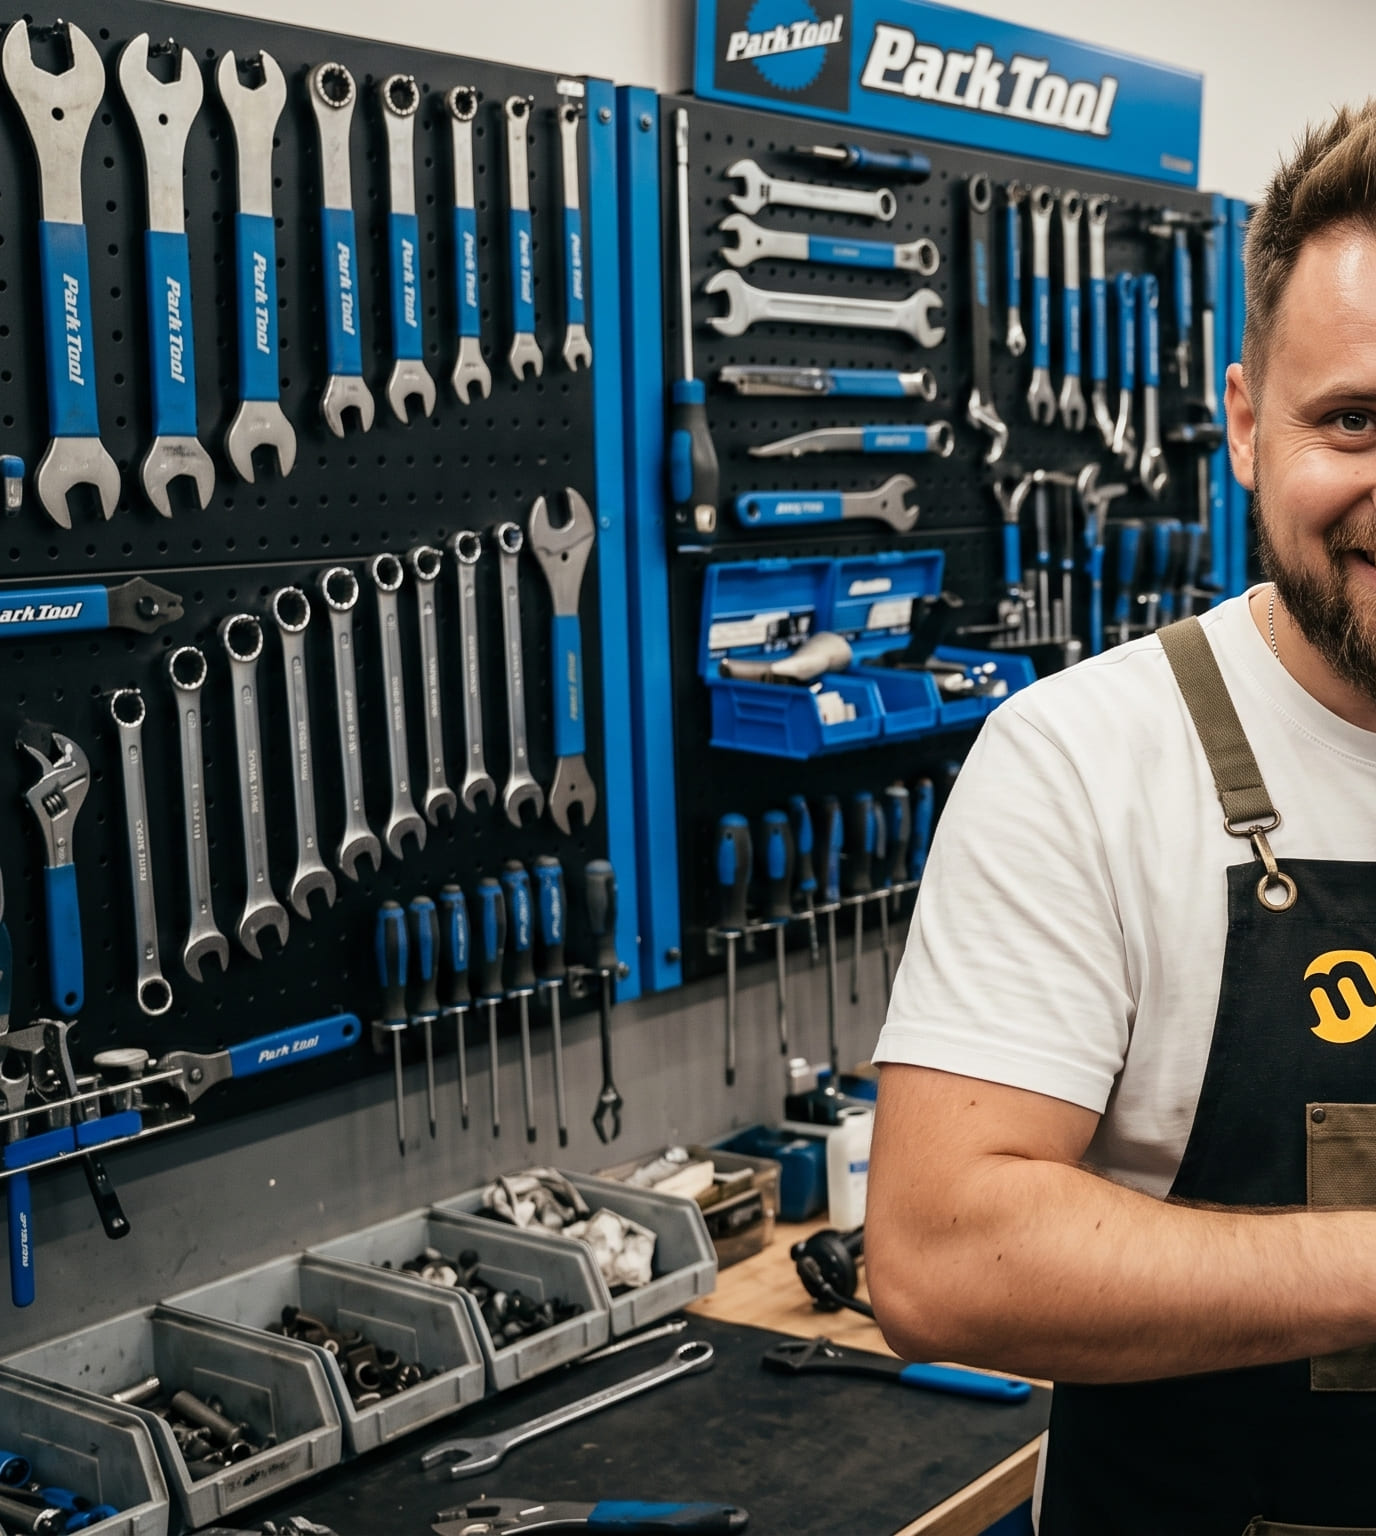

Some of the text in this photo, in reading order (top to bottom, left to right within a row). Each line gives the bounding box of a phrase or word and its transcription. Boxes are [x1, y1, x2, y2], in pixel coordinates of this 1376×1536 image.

[726, 14, 844, 62] Park Tool
[861, 24, 1119, 136] Park Tool
[63, 272, 85, 386] Park Tool
[166, 275, 186, 384] Park Tool
[253, 251, 270, 355] Park Tool
[36, 602, 83, 621] Tool
